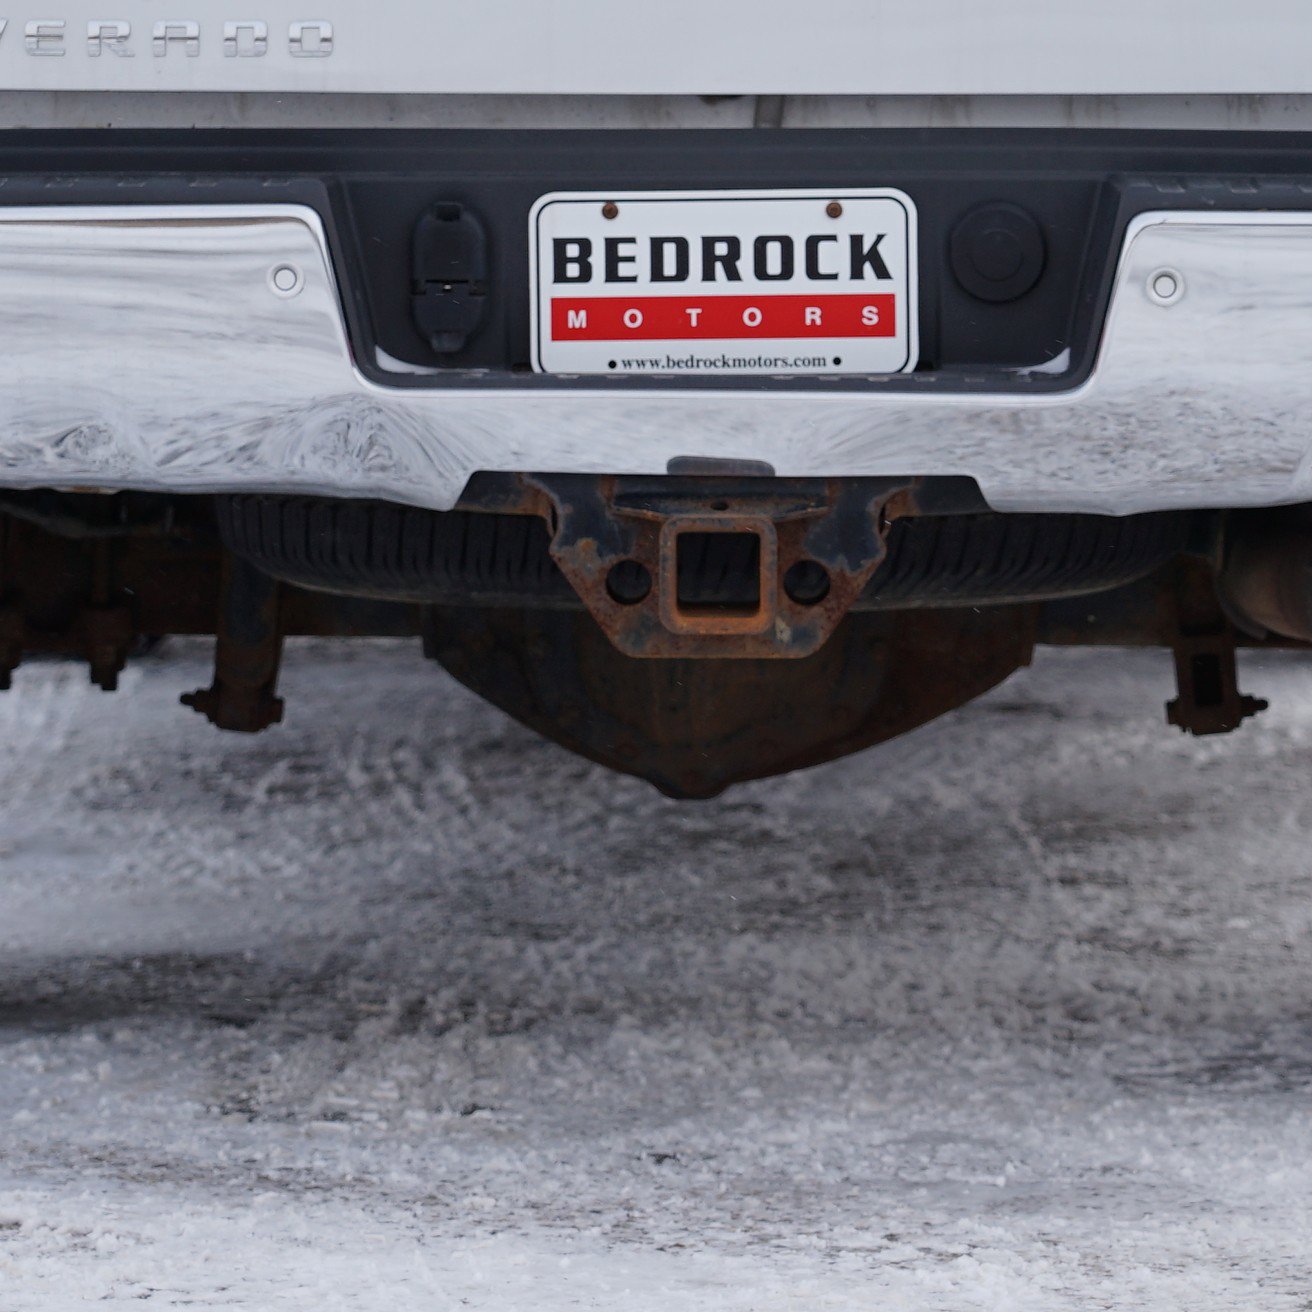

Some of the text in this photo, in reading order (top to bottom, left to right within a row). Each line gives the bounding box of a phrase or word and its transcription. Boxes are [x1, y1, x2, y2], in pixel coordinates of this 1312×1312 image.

[552, 233, 893, 283] BEDROCK
[567, 305, 880, 329] MOTORS
[621, 355, 827, 369] www.bedrockmotors.com
